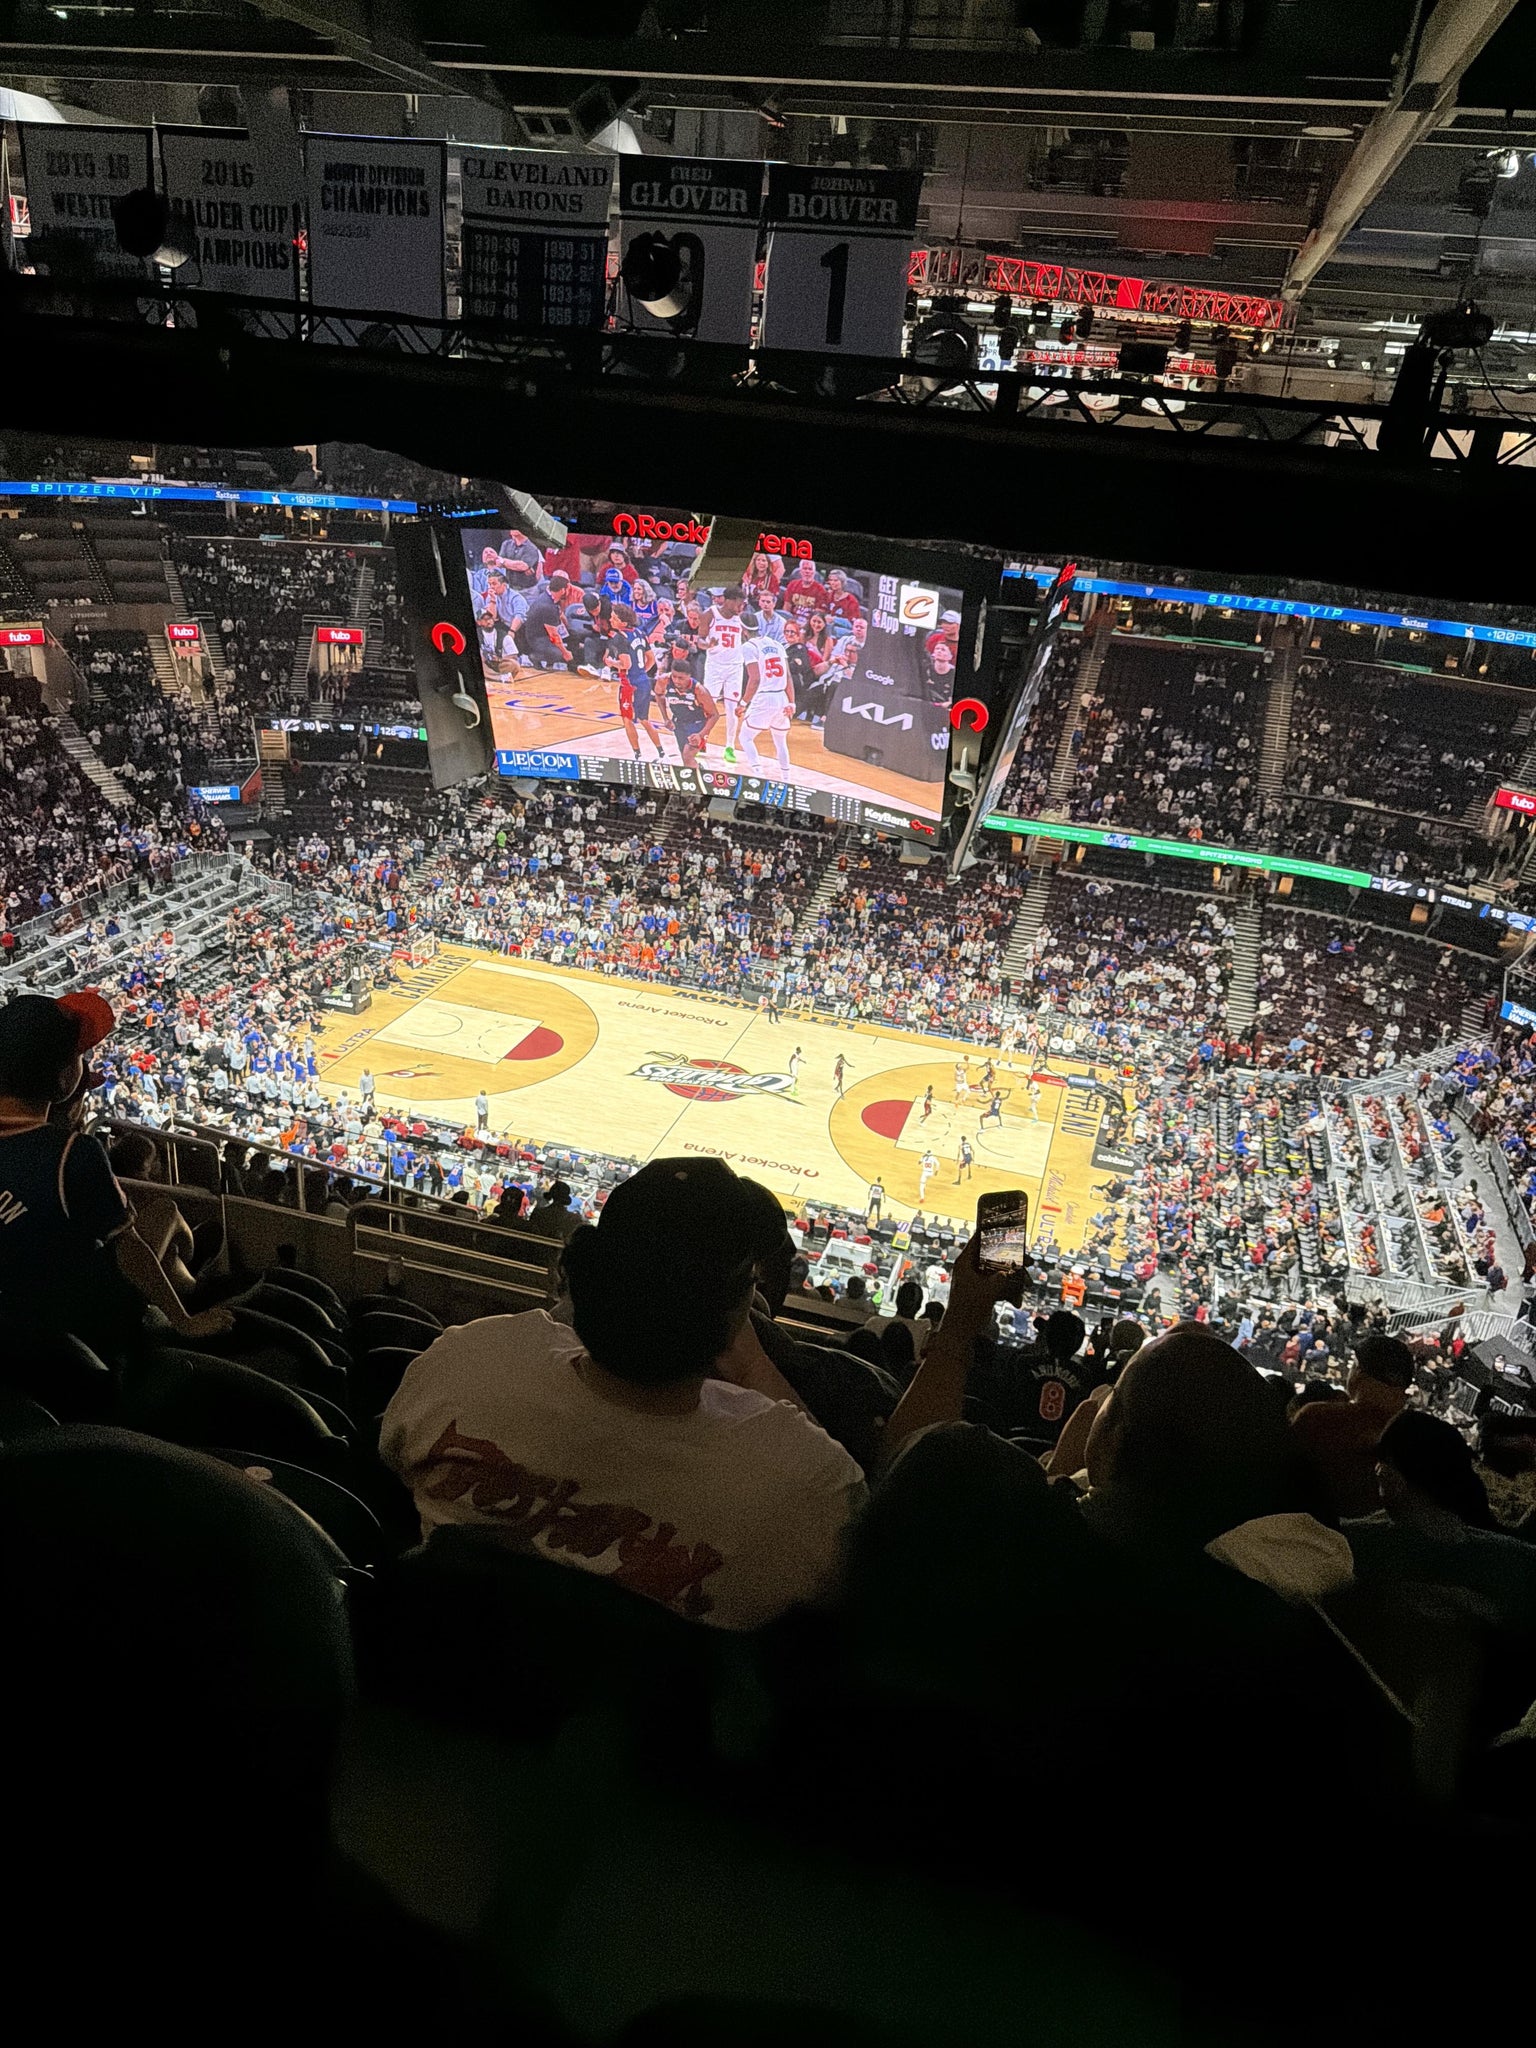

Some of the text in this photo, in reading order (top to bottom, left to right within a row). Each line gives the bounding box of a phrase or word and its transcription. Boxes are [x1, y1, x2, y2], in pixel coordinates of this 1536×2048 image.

[201, 159, 255, 188] 2016
[324, 162, 425, 186] NORTH DIVISION
[463, 158, 608, 187] CLEVELAND
[670, 166, 713, 182] FRED
[321, 184, 430, 217] CHAMPIONS
[486, 187, 583, 213] BARONS
[630, 181, 749, 214] GLOVER
[787, 192, 899, 224] BOWER
[251, 204, 288, 234] CUP
[203, 238, 289, 270] AMPIONS
[820, 243, 849, 344] 1
[30, 483, 162, 497] SPITZER VIP
[754, 532, 814, 560] rena
[879, 574, 899, 595] GET
[878, 593, 898, 613] THE
[1207, 593, 1344, 618] SPITZER VIP
[9, 631, 31, 643] fubo
[173, 626, 195, 639] fubo
[330, 630, 351, 642] fubo
[721, 633, 735, 648] 51
[765, 656, 784, 678] 55
[865, 669, 895, 686] Google
[842, 696, 914, 731] KIA
[303, 721, 315, 731] 90
[500, 752, 572, 768] LECOM
[682, 781, 696, 792] 90
[743, 790, 760, 801] 128
[1510, 795, 1535, 810] fubo
[864, 807, 910, 829] KeyBank
[1440, 894, 1473, 910] STEALS
[391, 954, 472, 1000] CAVALIERS
[618, 1000, 661, 1014] Arena
[663, 1009, 714, 1025] Rocket
[803, 1015, 857, 1031] LET
[333, 1028, 375, 1053] ULTRA
[630, 1062, 794, 1095] CAVALIERS
[683, 1142, 738, 1161] Arena
[738, 1154, 803, 1176] Rocket
